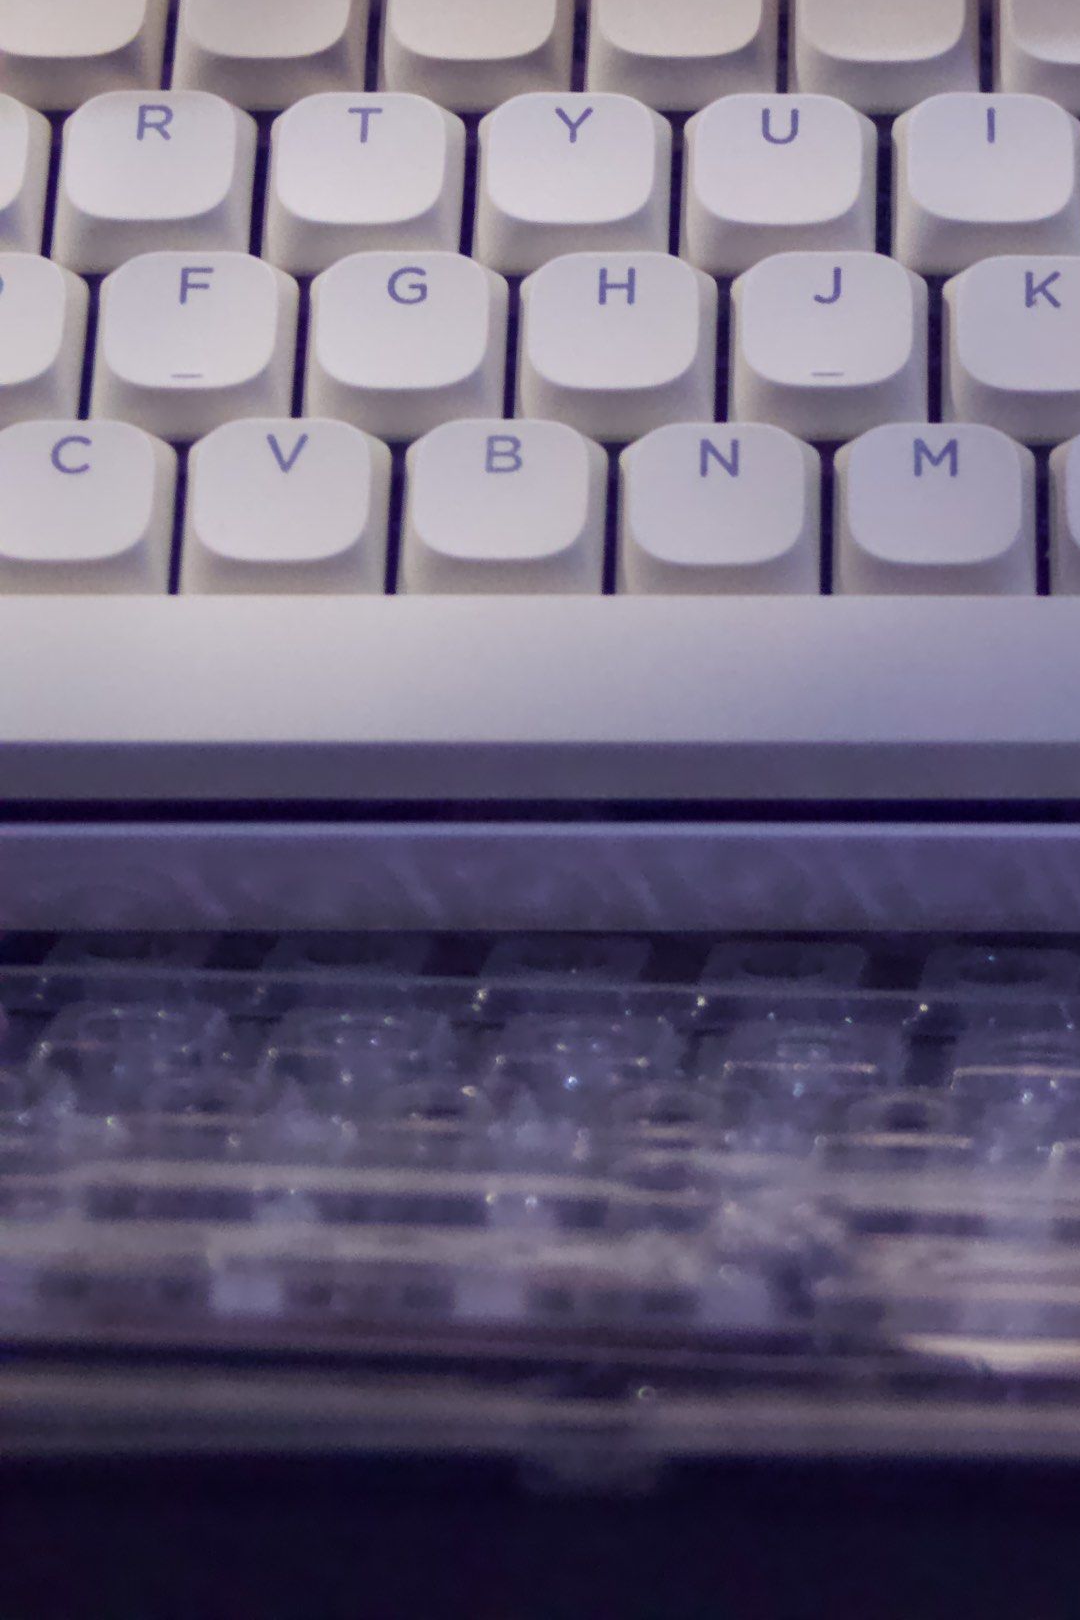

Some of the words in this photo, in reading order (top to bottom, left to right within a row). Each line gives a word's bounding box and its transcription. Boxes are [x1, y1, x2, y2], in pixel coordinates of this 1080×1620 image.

[136, 103, 174, 142] R
[347, 106, 384, 144] T
[554, 106, 594, 144] Y
[761, 107, 800, 145] U
[986, 106, 996, 144] I
[179, 266, 215, 305] F
[386, 266, 428, 306] G
[597, 266, 636, 306] H
[813, 266, 842, 305] J
[1024, 270, 1062, 309] K
[49, 435, 93, 475] C
[266, 433, 309, 474] V
[484, 434, 523, 474] B
[699, 438, 740, 478] N
[913, 438, 959, 478] M
